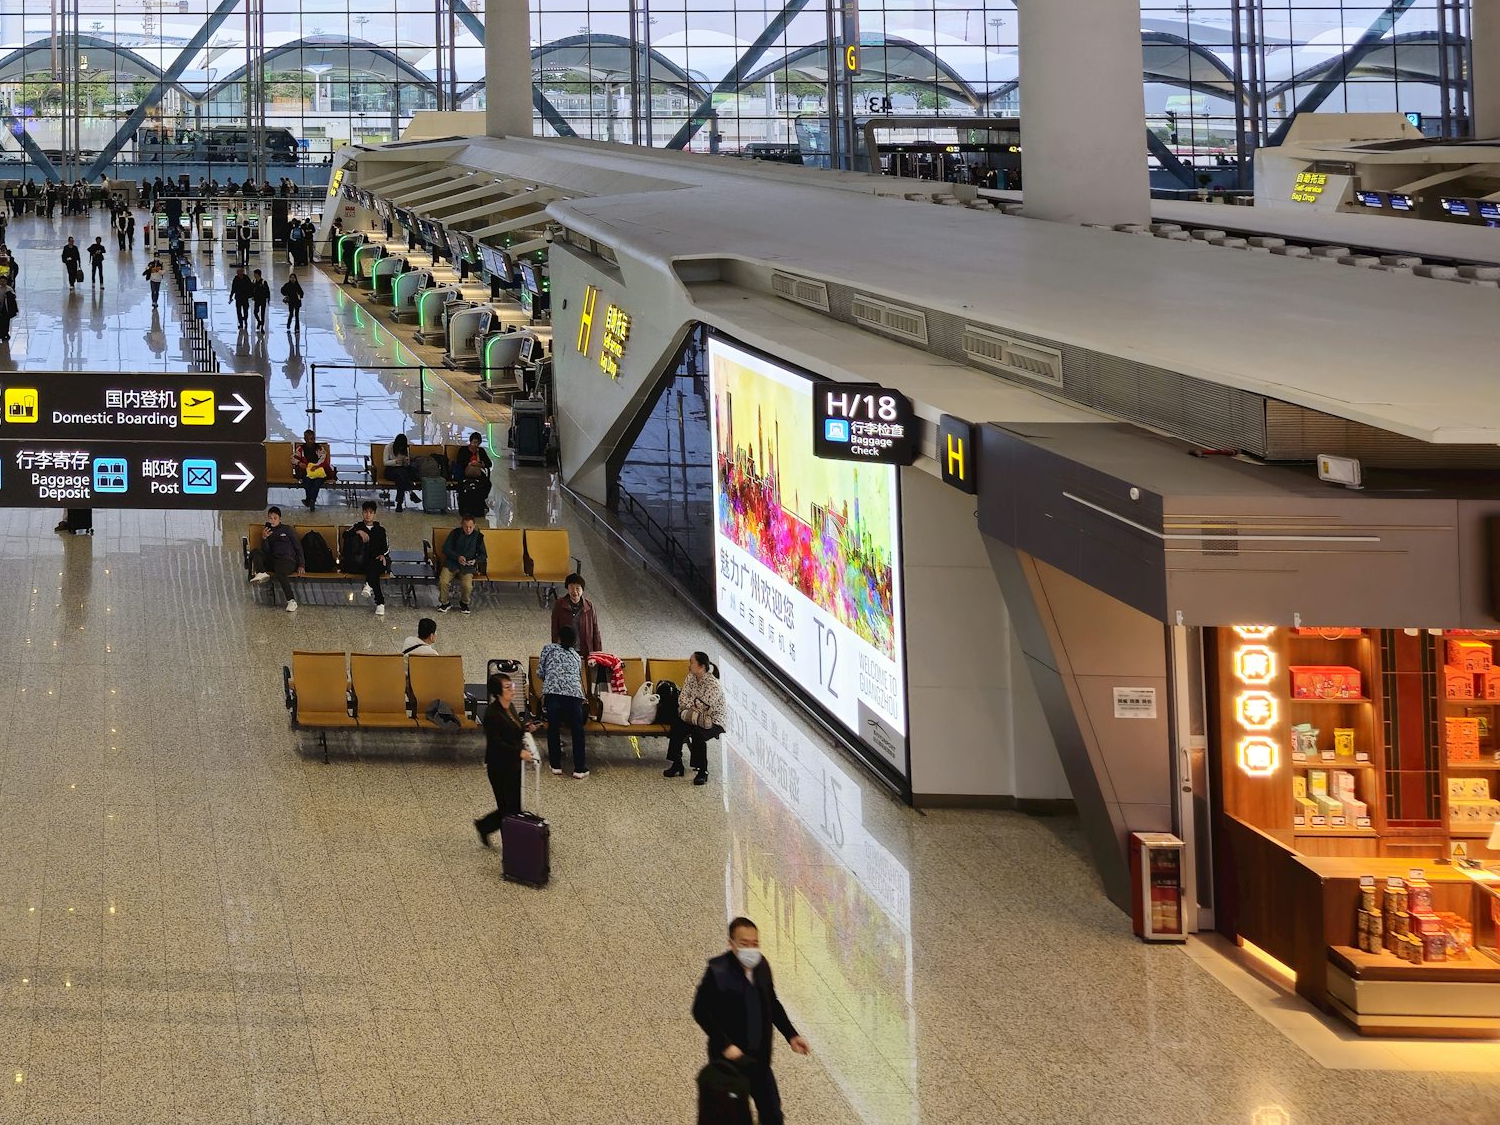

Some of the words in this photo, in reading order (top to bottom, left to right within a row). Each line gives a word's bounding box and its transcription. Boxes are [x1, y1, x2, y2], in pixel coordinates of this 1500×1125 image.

[847, 45, 856, 71] G
[1291, 192, 1302, 202] Bag
[1302, 194, 1315, 203] Drop
[577, 284, 597, 357] H
[105, 389, 177, 409] 国内登机
[826, 392, 898, 422] H/18
[52, 412, 114, 425] Domestic
[117, 413, 178, 428] Boarding
[850, 420, 905, 439] 行李检查
[850, 435, 893, 448] Baggage
[850, 446, 880, 457] Check
[16, 450, 90, 470] 行李寄存
[947, 433, 965, 481] H
[142, 459, 179, 479] 邮政
[31, 473, 90, 488] Baggage
[151, 482, 180, 494] Post
[39, 486, 91, 501] Deposit
[720, 547, 795, 630] 魅力广州欢迎您
[813, 617, 839, 699] T2
[858, 650, 888, 690] WELCOME
[888, 674, 898, 697] TO
[859, 672, 899, 720] GUANGZHOU
